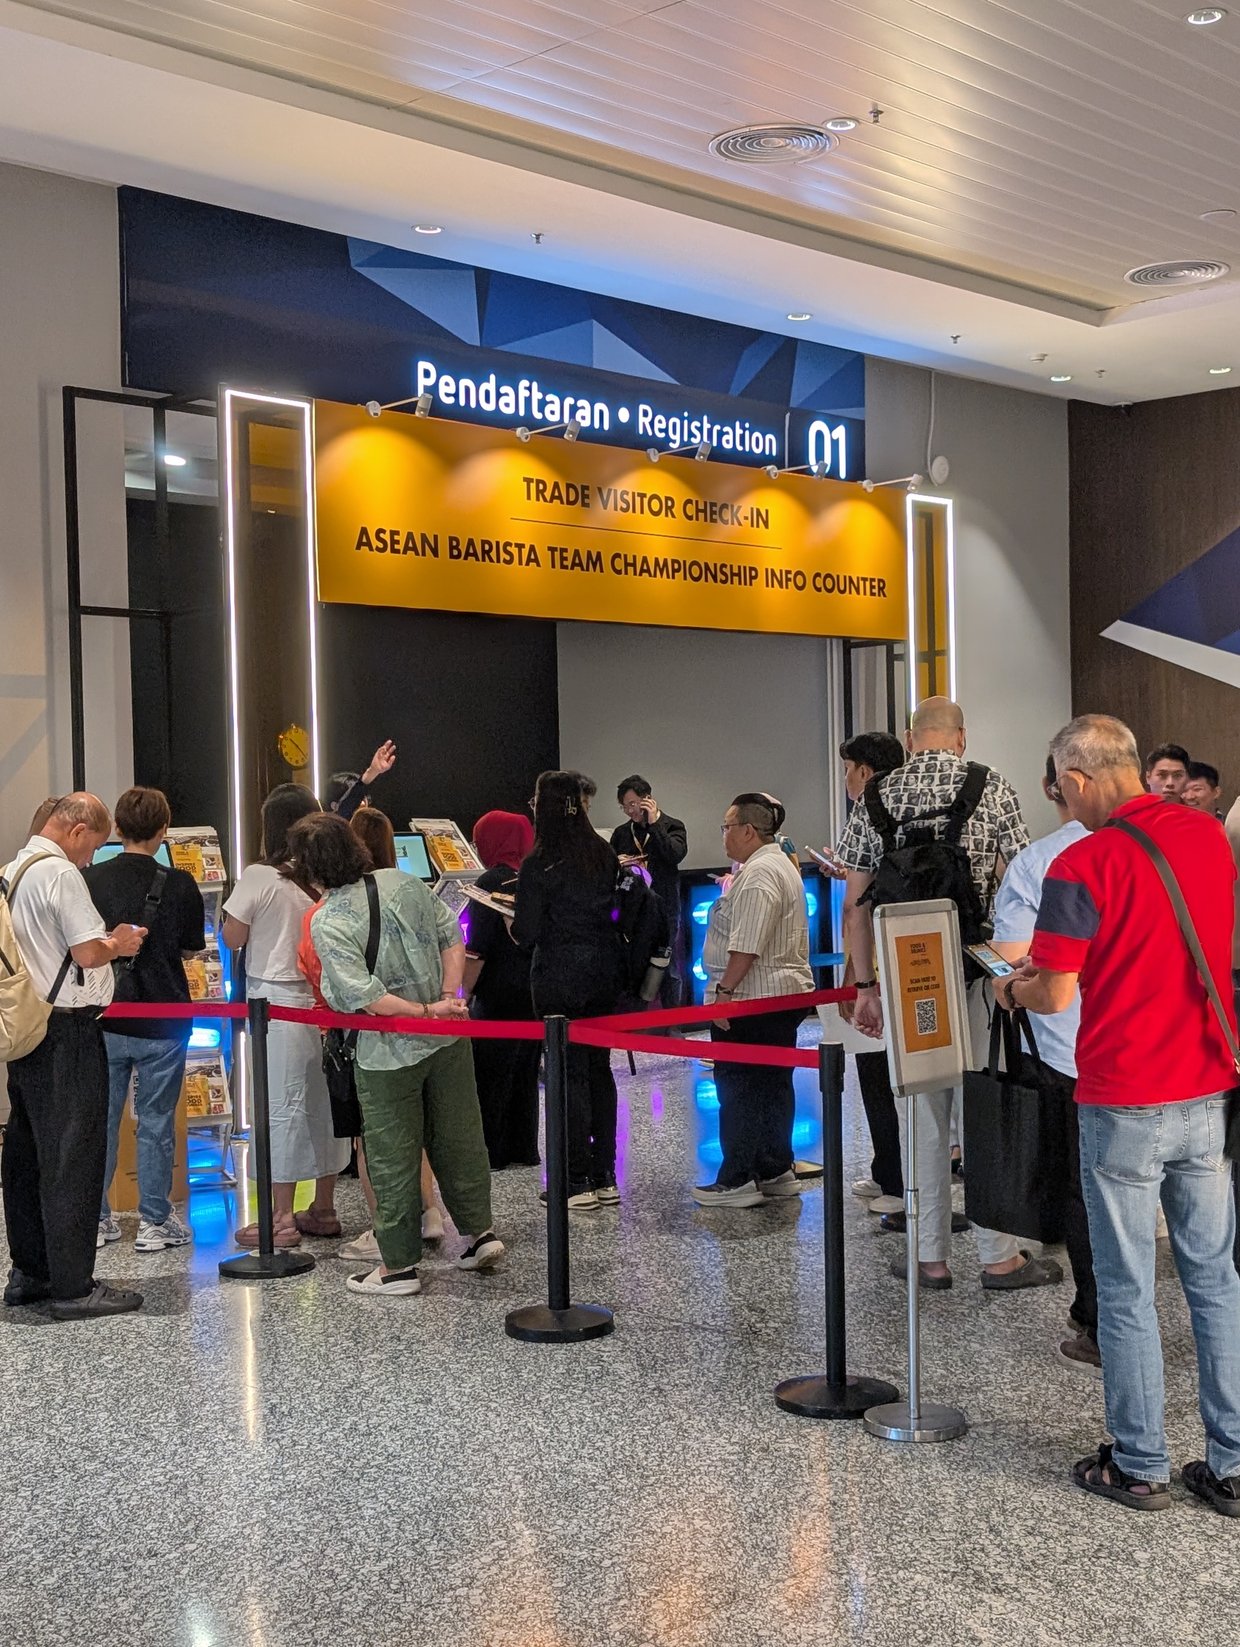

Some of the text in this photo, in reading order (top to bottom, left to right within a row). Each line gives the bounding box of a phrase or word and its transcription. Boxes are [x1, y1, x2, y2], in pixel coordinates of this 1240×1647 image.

[416, 360, 848, 480] Pendaftaran Registration 01
[522, 477, 770, 530] TRADE VISITOR CHECK-IN
[356, 526, 887, 598] ASEAN BARISTA TEAM CHAMPIONSHIP INFO COUNTER
